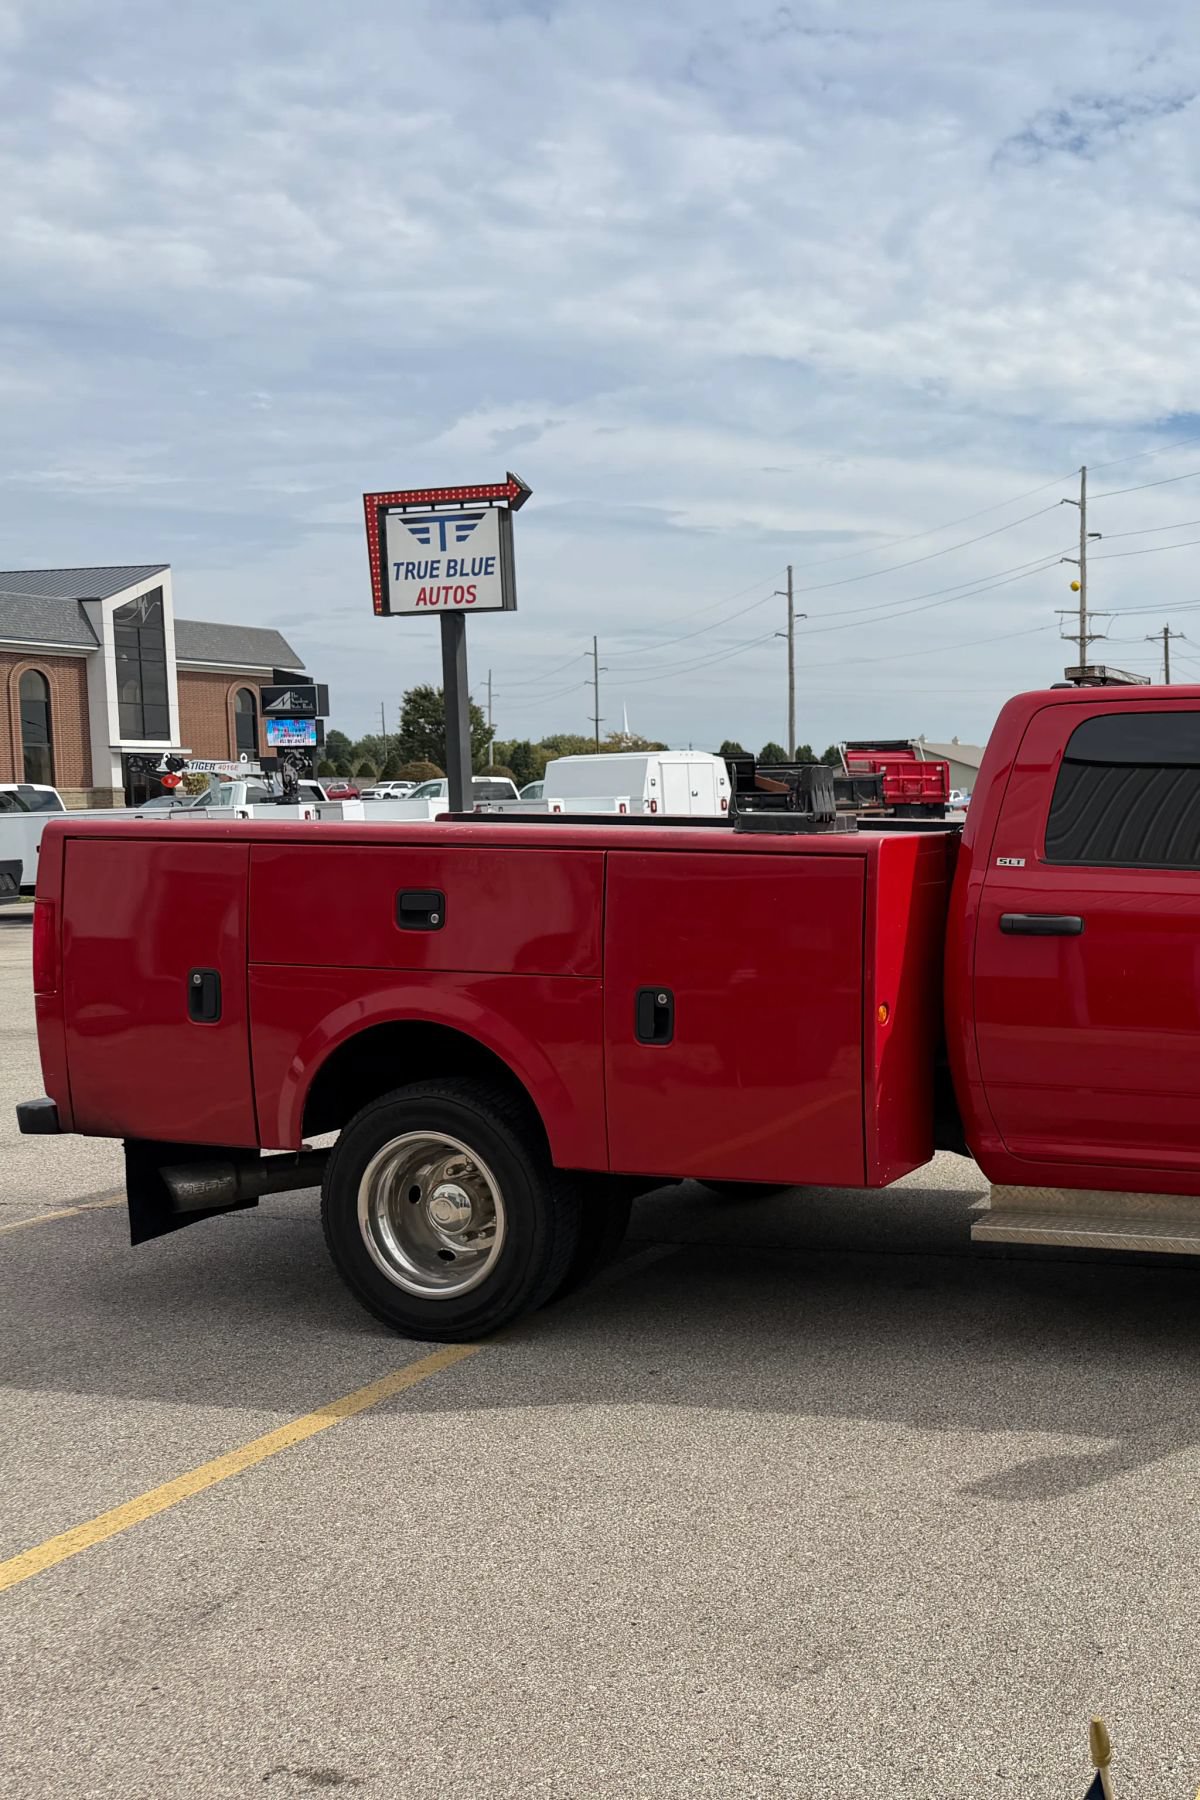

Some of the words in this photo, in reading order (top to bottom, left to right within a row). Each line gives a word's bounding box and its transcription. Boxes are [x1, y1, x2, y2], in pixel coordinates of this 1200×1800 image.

[393, 559, 441, 581] TRUE
[446, 556, 496, 578] BLUE
[415, 584, 477, 606] AUTOS
[190, 761, 216, 771] TIGER
[999, 858, 1023, 866] SLT
